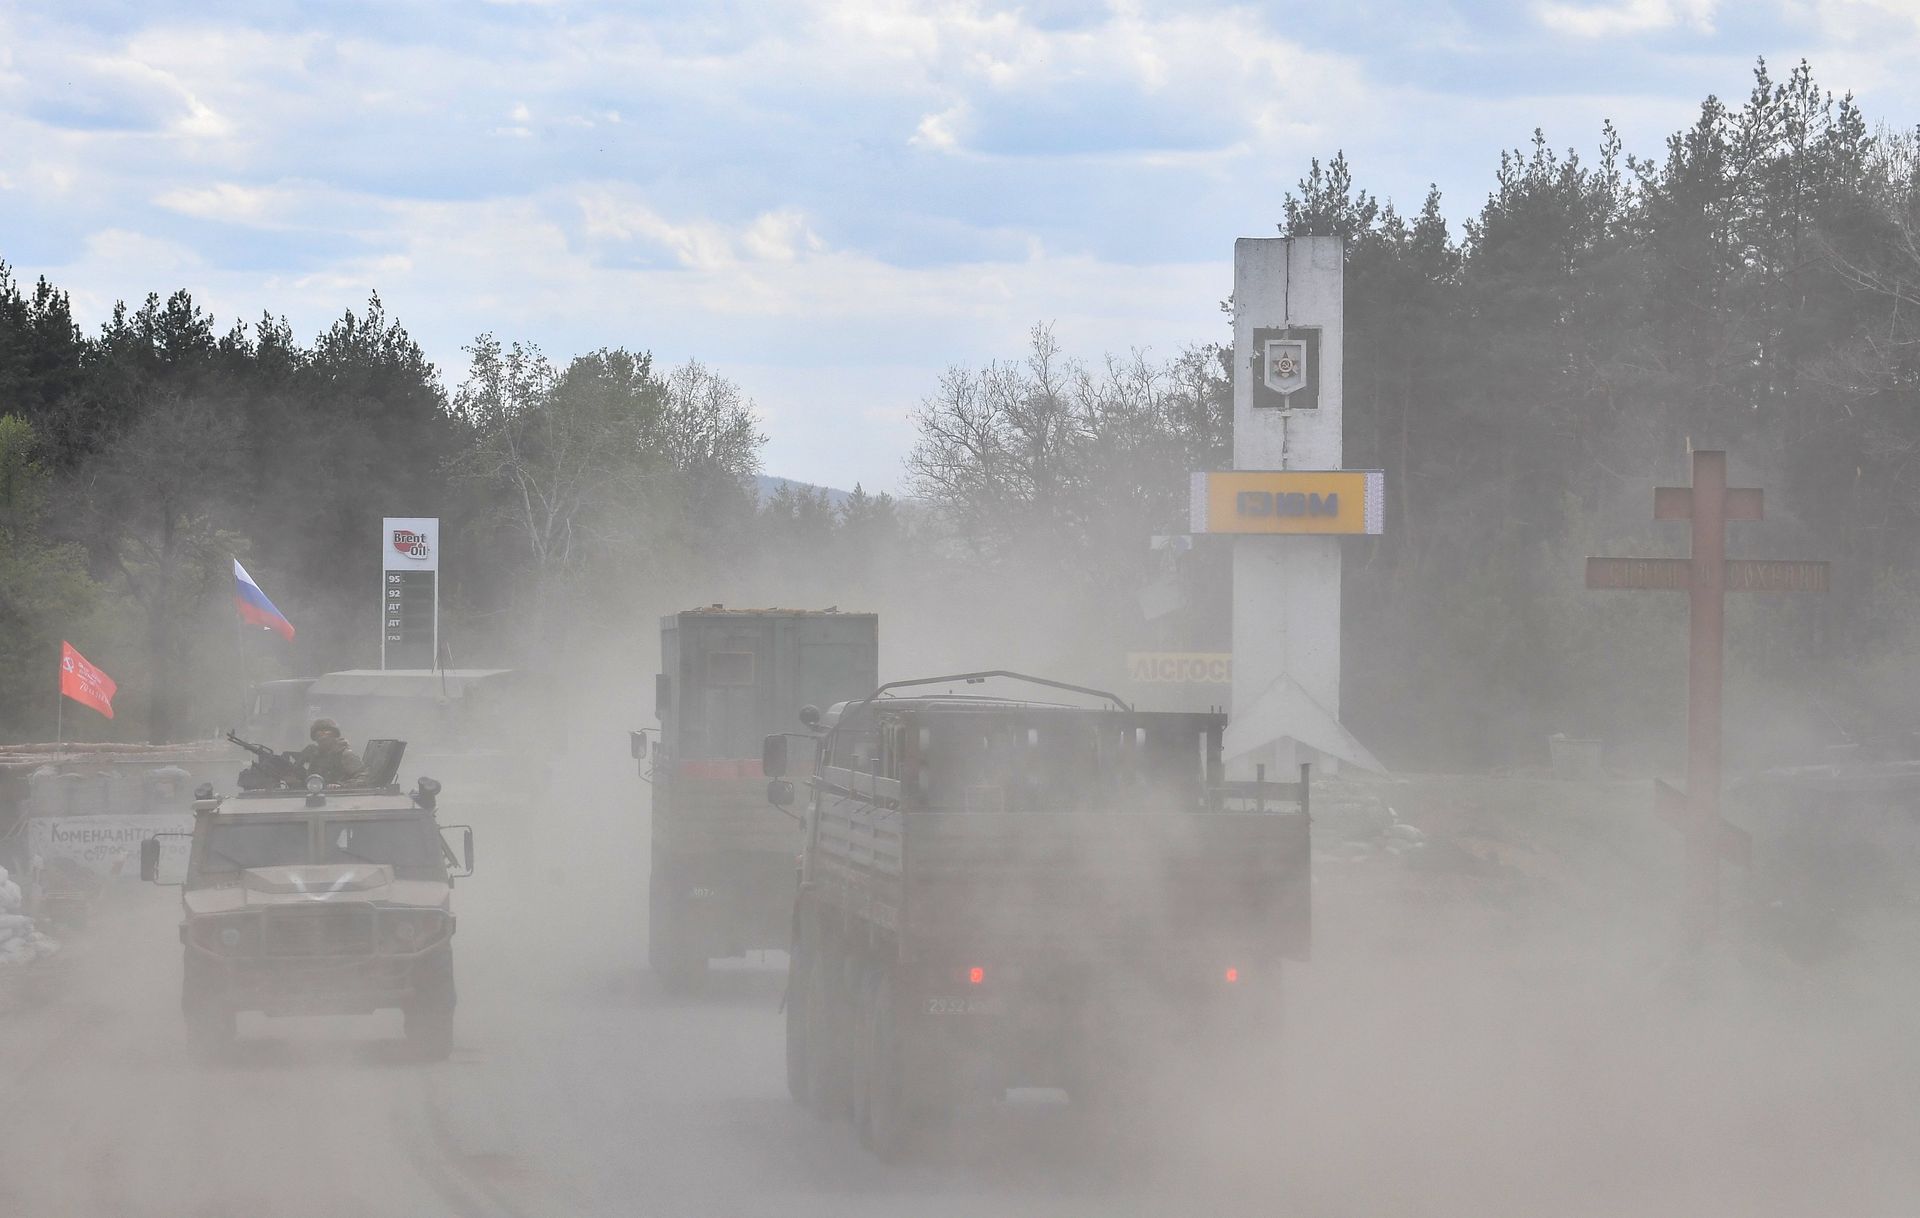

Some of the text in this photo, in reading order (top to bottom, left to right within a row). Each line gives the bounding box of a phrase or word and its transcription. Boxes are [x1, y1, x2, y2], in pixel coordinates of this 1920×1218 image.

[394, 533, 427, 543] Brent
[410, 543, 426, 556] Oil
[388, 575, 401, 583] 95
[388, 589, 401, 598] 92
[387, 603, 401, 611] ДТ
[387, 619, 401, 627] ДТ
